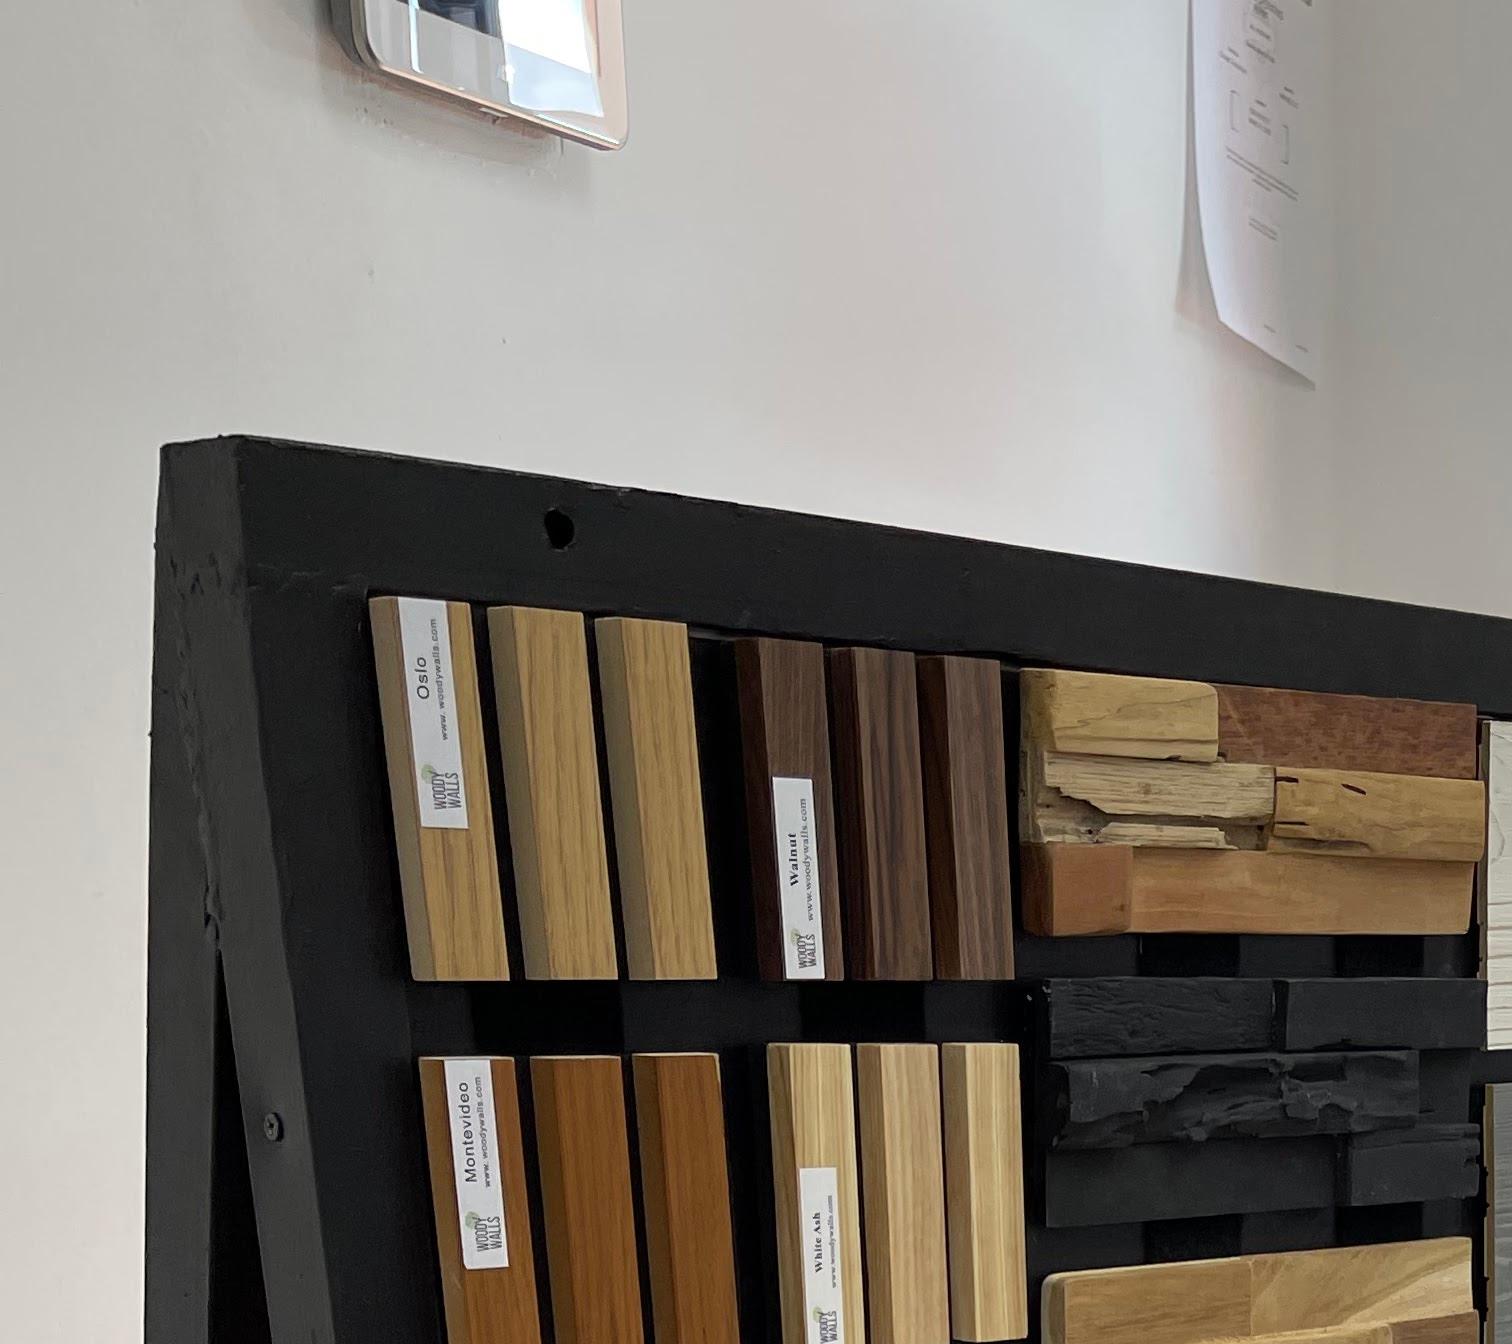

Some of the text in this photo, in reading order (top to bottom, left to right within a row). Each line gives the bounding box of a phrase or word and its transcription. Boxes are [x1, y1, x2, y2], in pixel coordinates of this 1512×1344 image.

[414, 657, 430, 699] Oslo
[431, 771, 447, 809] WOODY
[445, 772, 461, 808] WALLS
[787, 833, 799, 886] Walnut
[799, 798, 814, 921] www.woodywalls.com
[796, 934, 807, 968] WOODY
[806, 934, 817, 967] WALLS
[458, 1082, 477, 1182] Montevideo
[475, 1217, 489, 1252] WOODY
[487, 1216, 502, 1249] WALLS
[812, 1212, 823, 1272] White Ash
[818, 1311, 829, 1344] WOODY
[827, 1311, 838, 1342] WALLS
